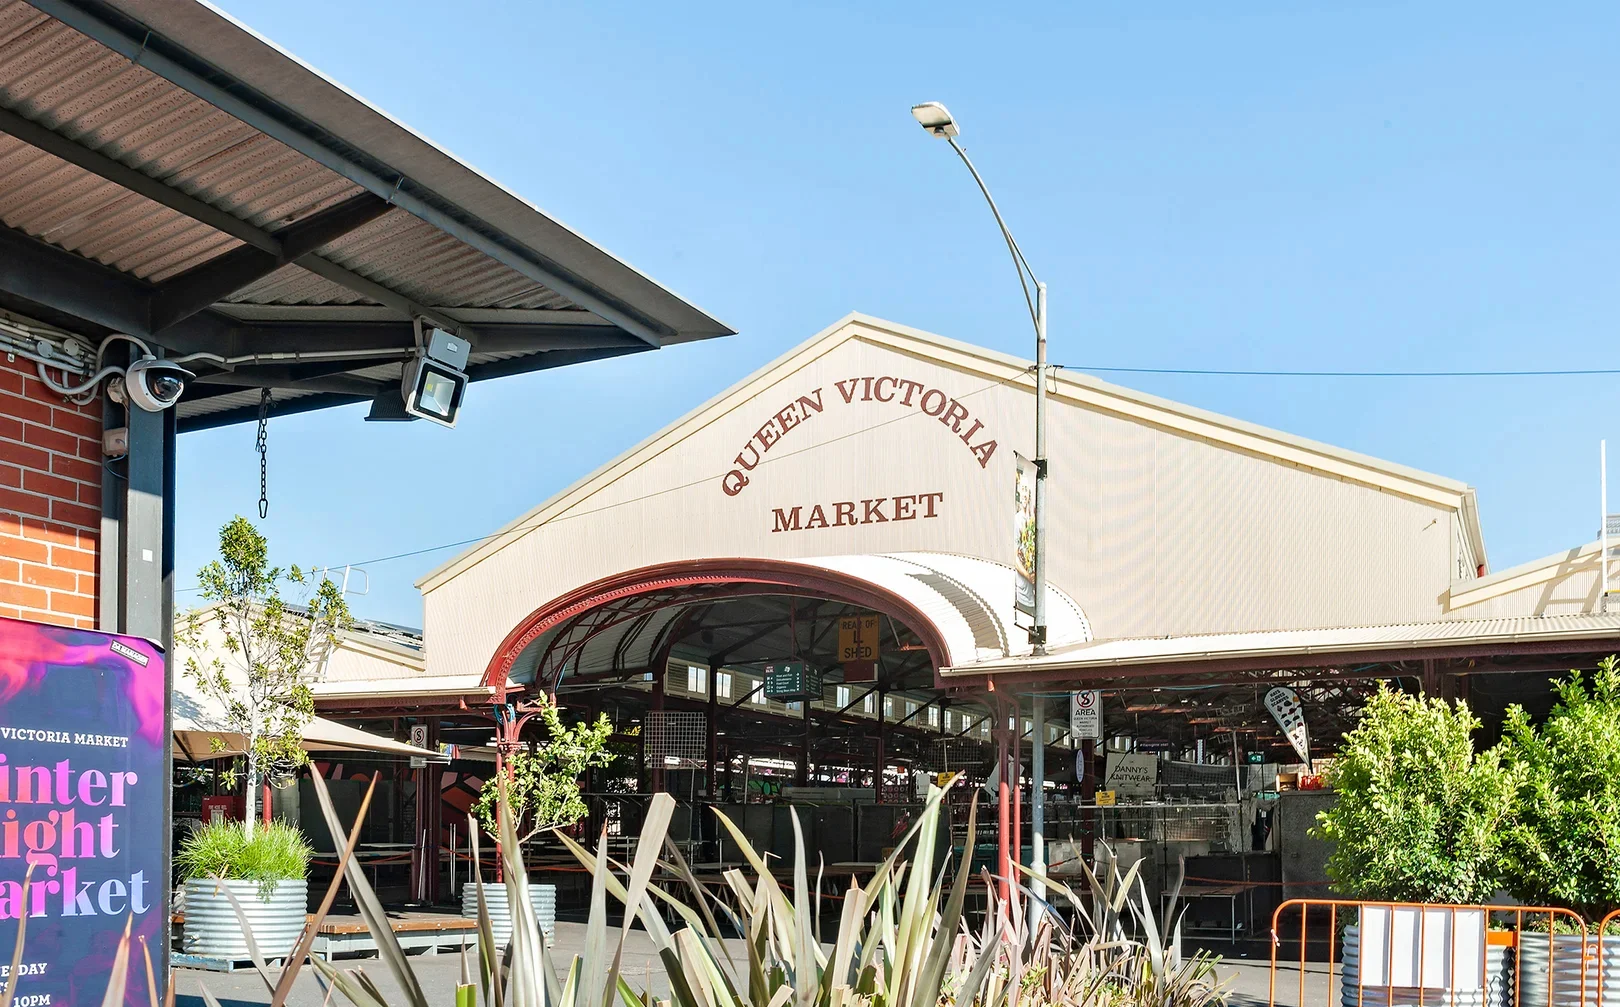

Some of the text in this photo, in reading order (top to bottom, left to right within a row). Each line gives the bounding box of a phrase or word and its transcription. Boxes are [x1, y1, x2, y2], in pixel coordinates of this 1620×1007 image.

[722, 376, 998, 497] QUEEN VICTORIA
[771, 492, 944, 533] MARKET
[842, 619, 876, 630] REA OF
[853, 630, 864, 644] L
[844, 646, 872, 659] SHED
[1075, 708, 1096, 716] AREA
[0, 727, 128, 748] VICTORIA MARKET
[1114, 765, 1148, 774] DANNY'S
[1110, 774, 1151, 783] KNITWEAR
[0, 963, 47, 977] EDAY
[14, 994, 51, 1007] 10PM
